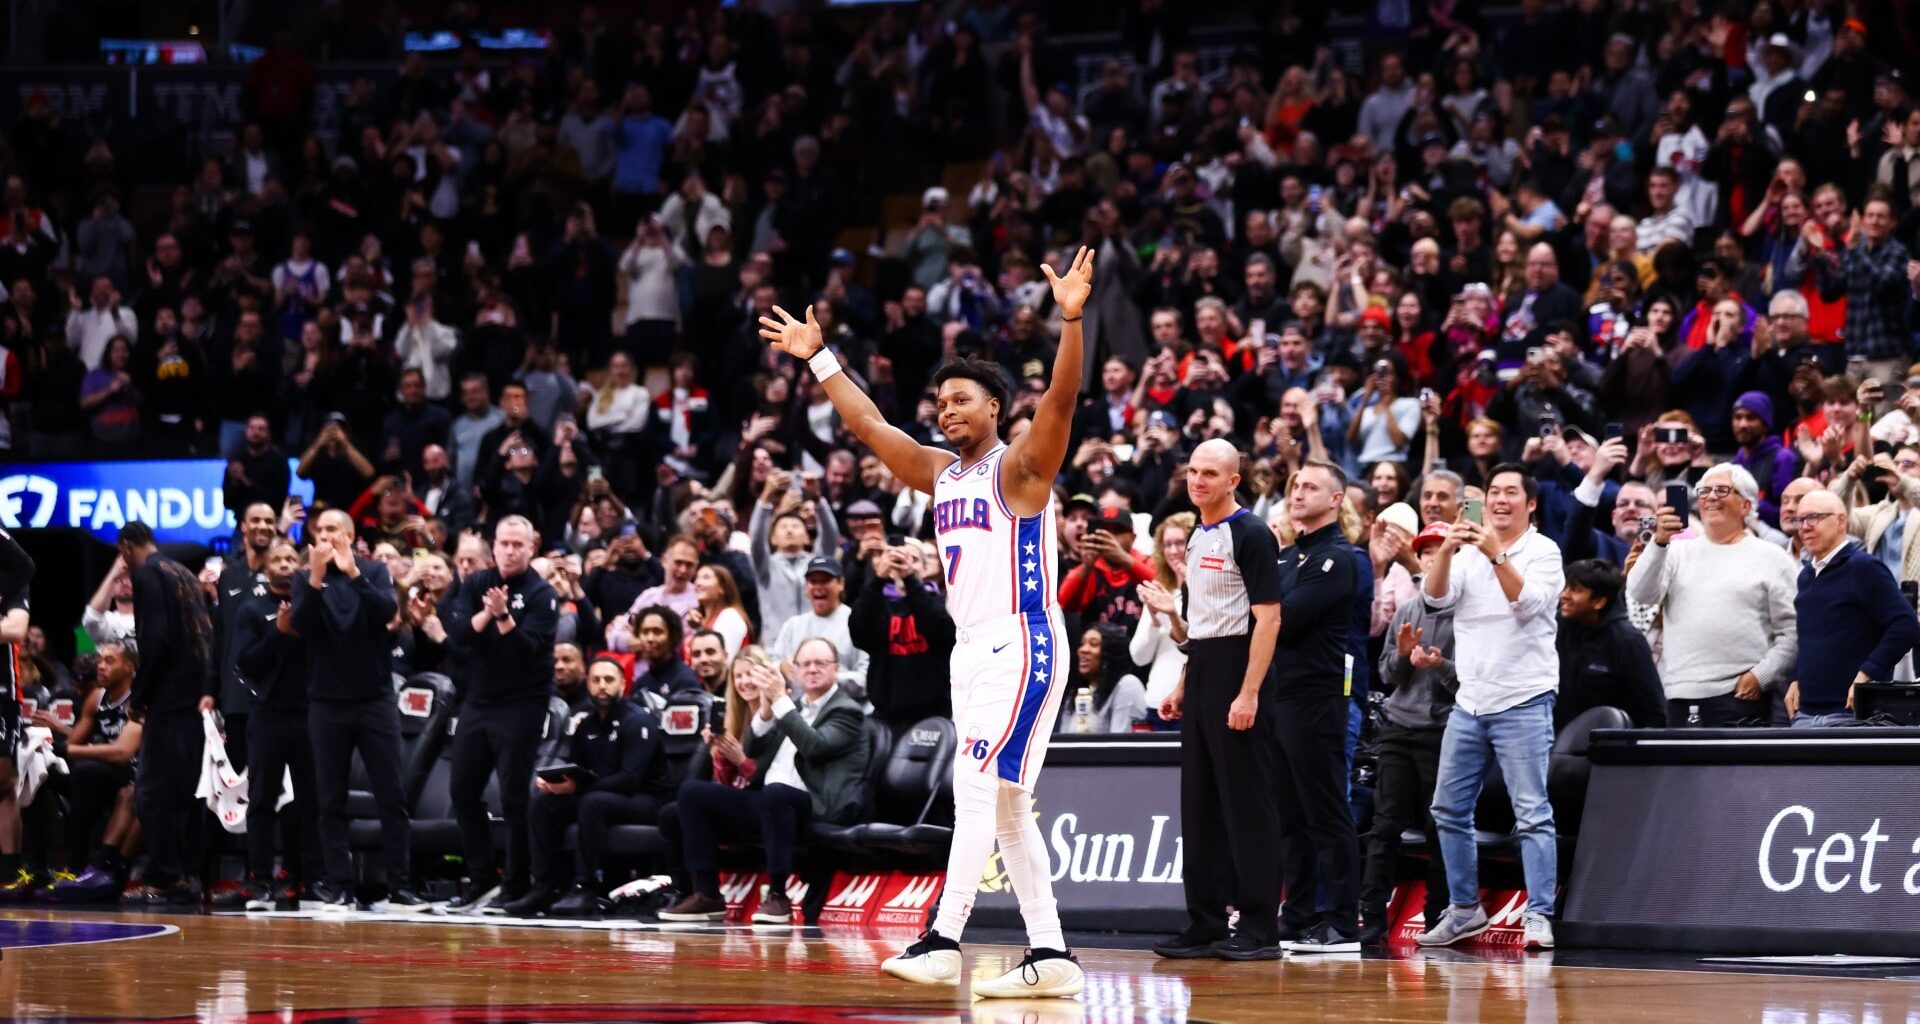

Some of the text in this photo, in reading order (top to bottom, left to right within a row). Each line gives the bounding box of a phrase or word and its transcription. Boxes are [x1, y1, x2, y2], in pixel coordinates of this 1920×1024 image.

[946, 545, 962, 585] 7
[961, 736, 989, 760] 76
[1051, 813, 1134, 883] Sun
[1758, 805, 1889, 894] Get
